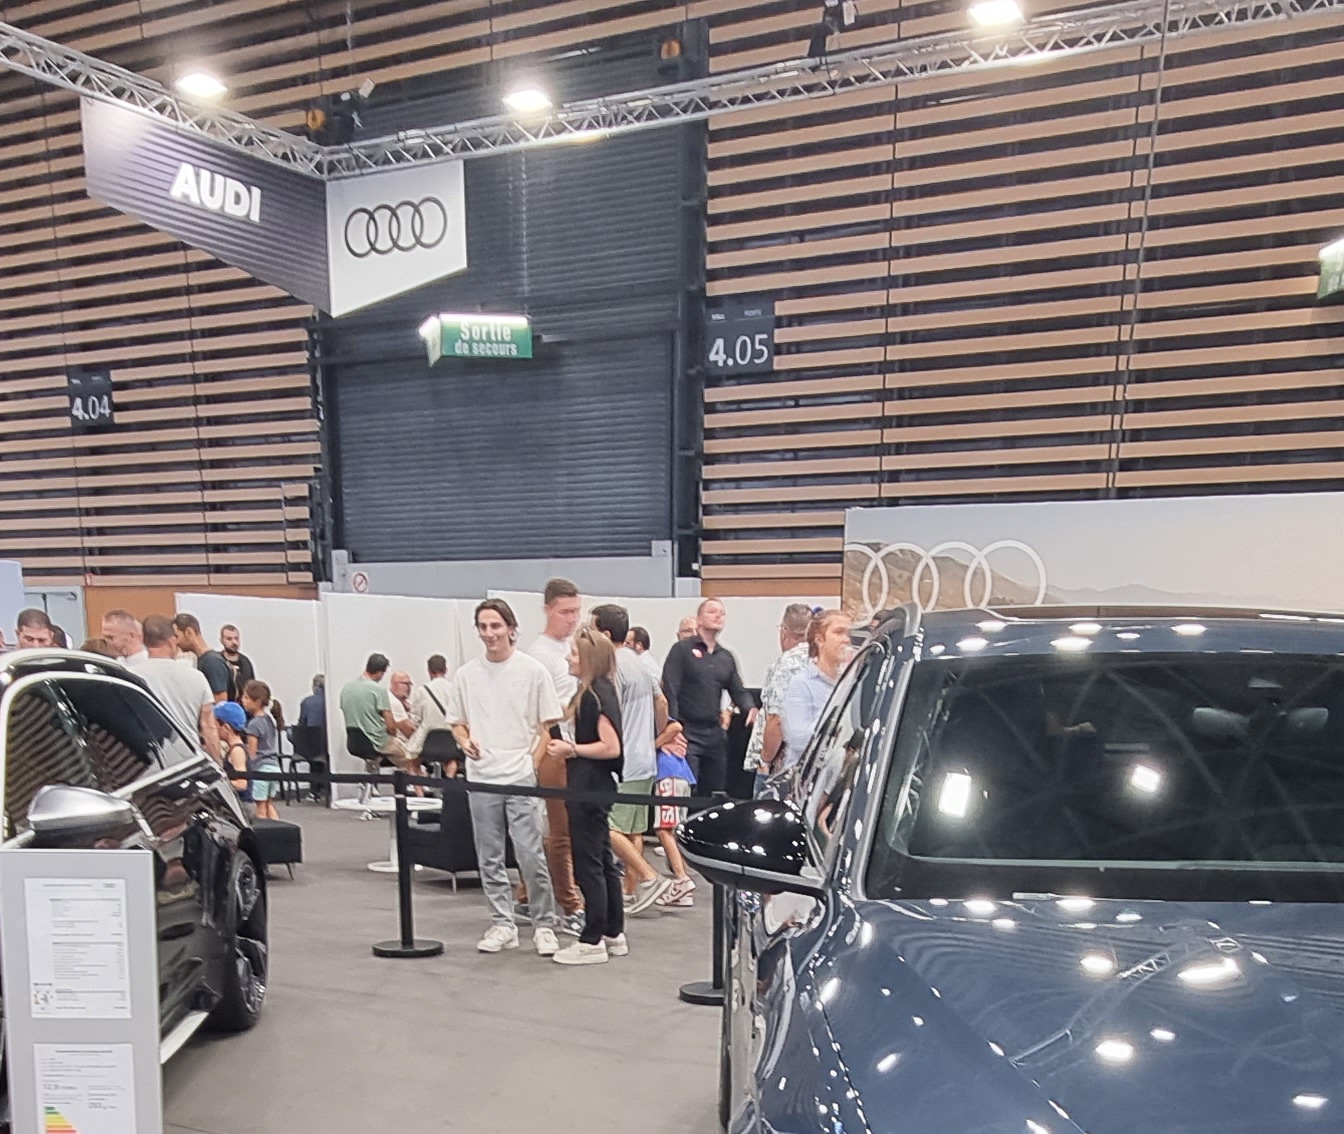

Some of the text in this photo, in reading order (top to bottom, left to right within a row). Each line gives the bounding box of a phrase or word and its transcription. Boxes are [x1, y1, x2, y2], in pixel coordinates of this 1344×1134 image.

[170, 162, 262, 222] AUDI
[460, 321, 511, 341] Sortie
[455, 339, 517, 356] de secours
[709, 333, 769, 367] 4.05
[71, 395, 111, 420] 4.04
